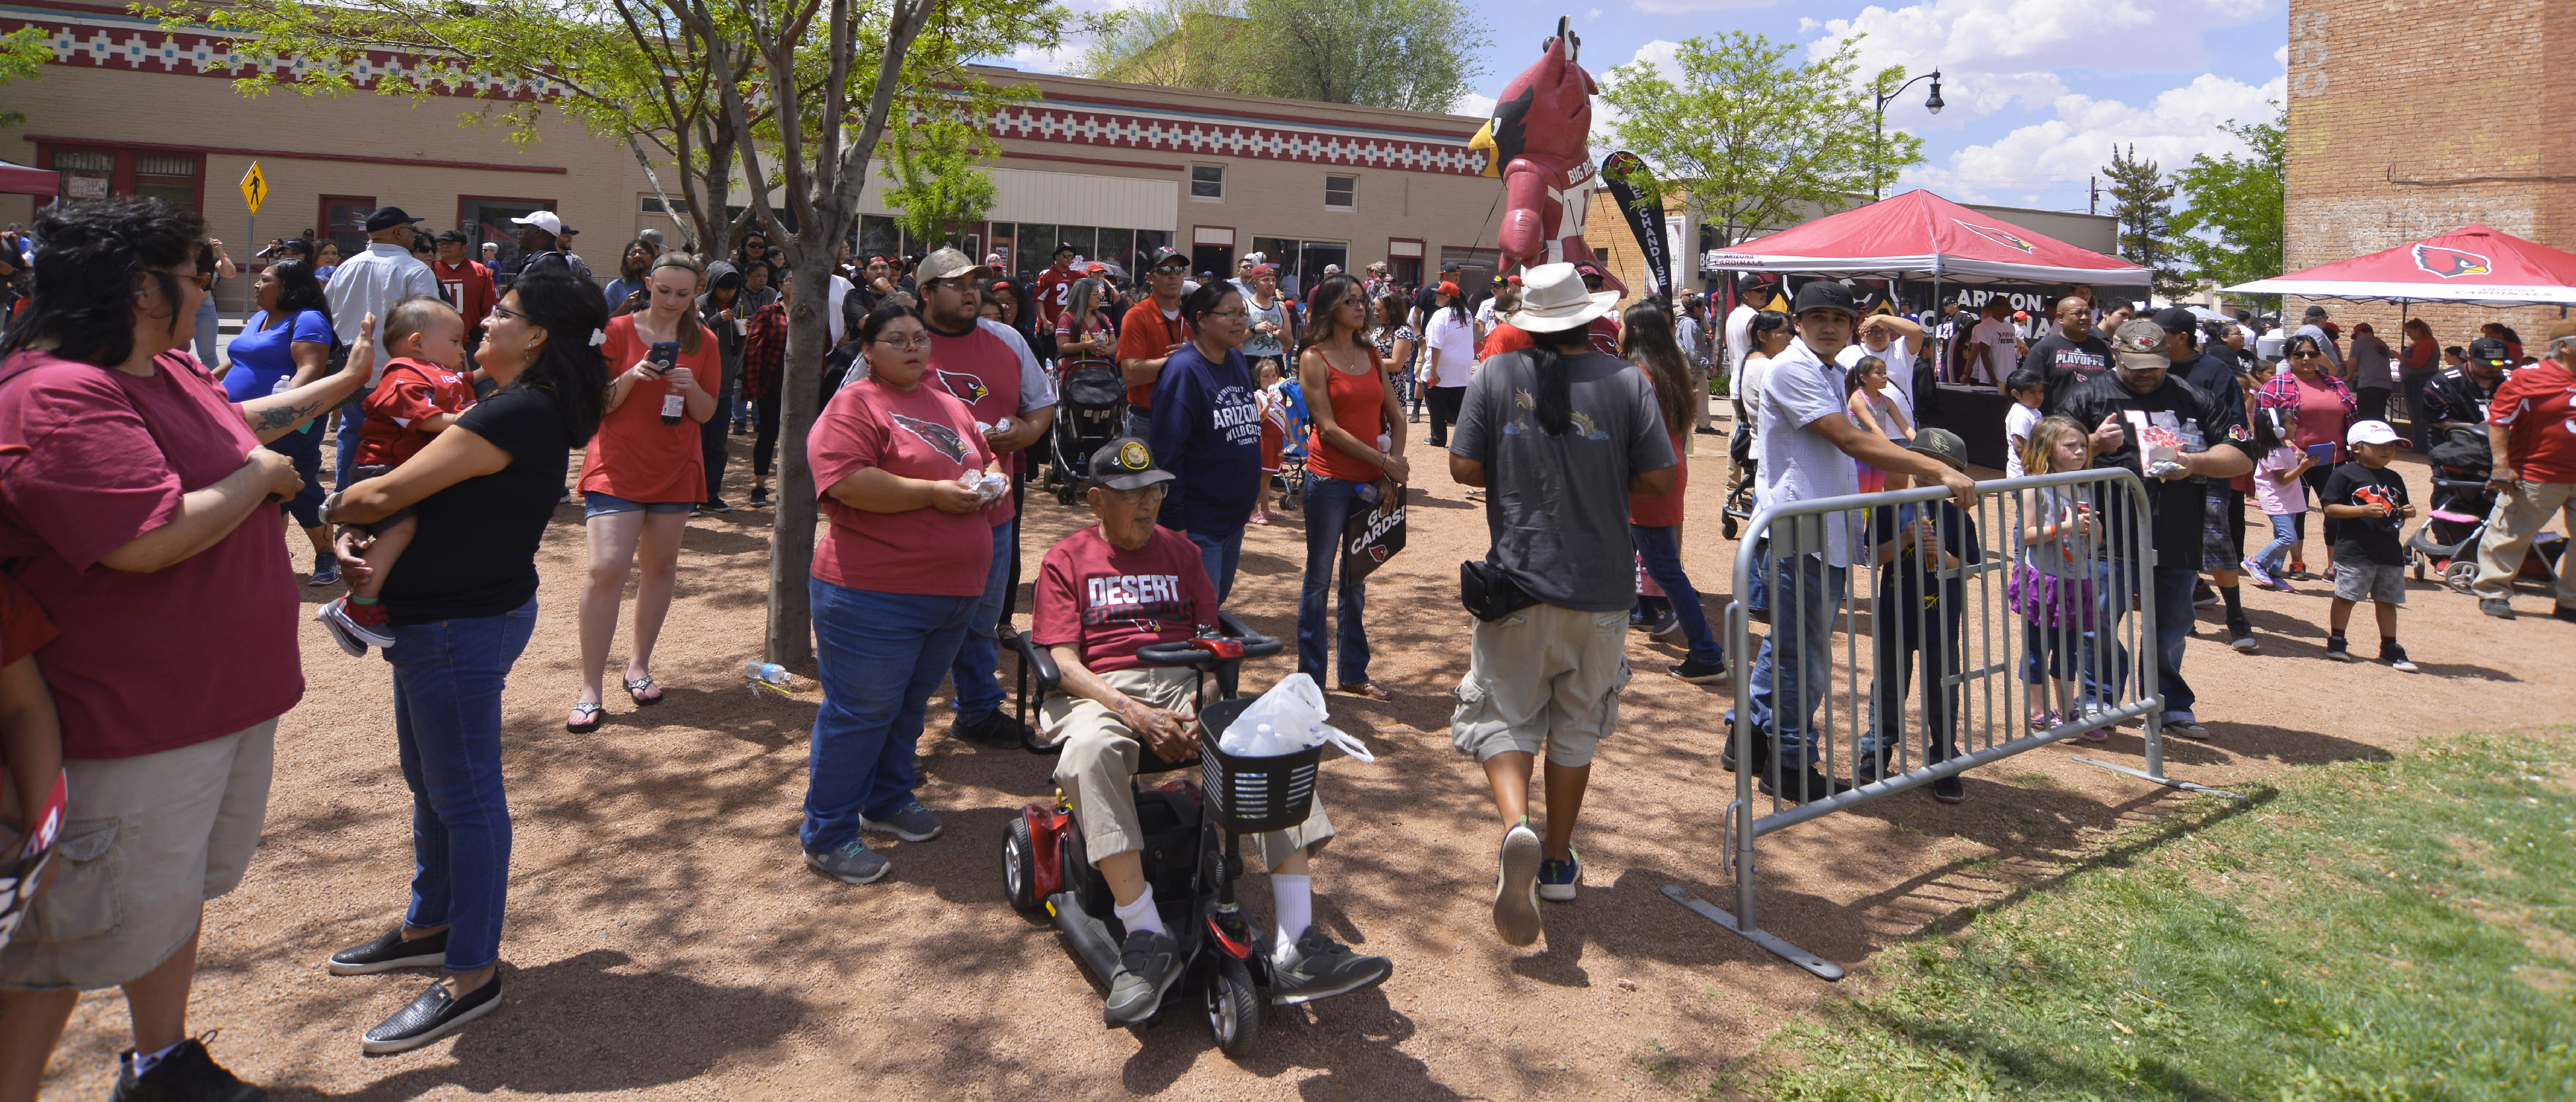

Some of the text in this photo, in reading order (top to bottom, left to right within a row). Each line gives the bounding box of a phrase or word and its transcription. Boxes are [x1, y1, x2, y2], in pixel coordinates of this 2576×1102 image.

[1567, 156, 1595, 185] BIG RE
[1629, 181, 1667, 286] MECHANDISE
[2055, 353, 2105, 366] PLAYOFFS
[1213, 403, 1261, 430] ARIZON
[1226, 423, 1262, 442] WILDCATS
[1351, 504, 1406, 555] CARDS!
[1088, 574, 1179, 608] DESERT
[1083, 598, 1191, 626] FOOTBALL
